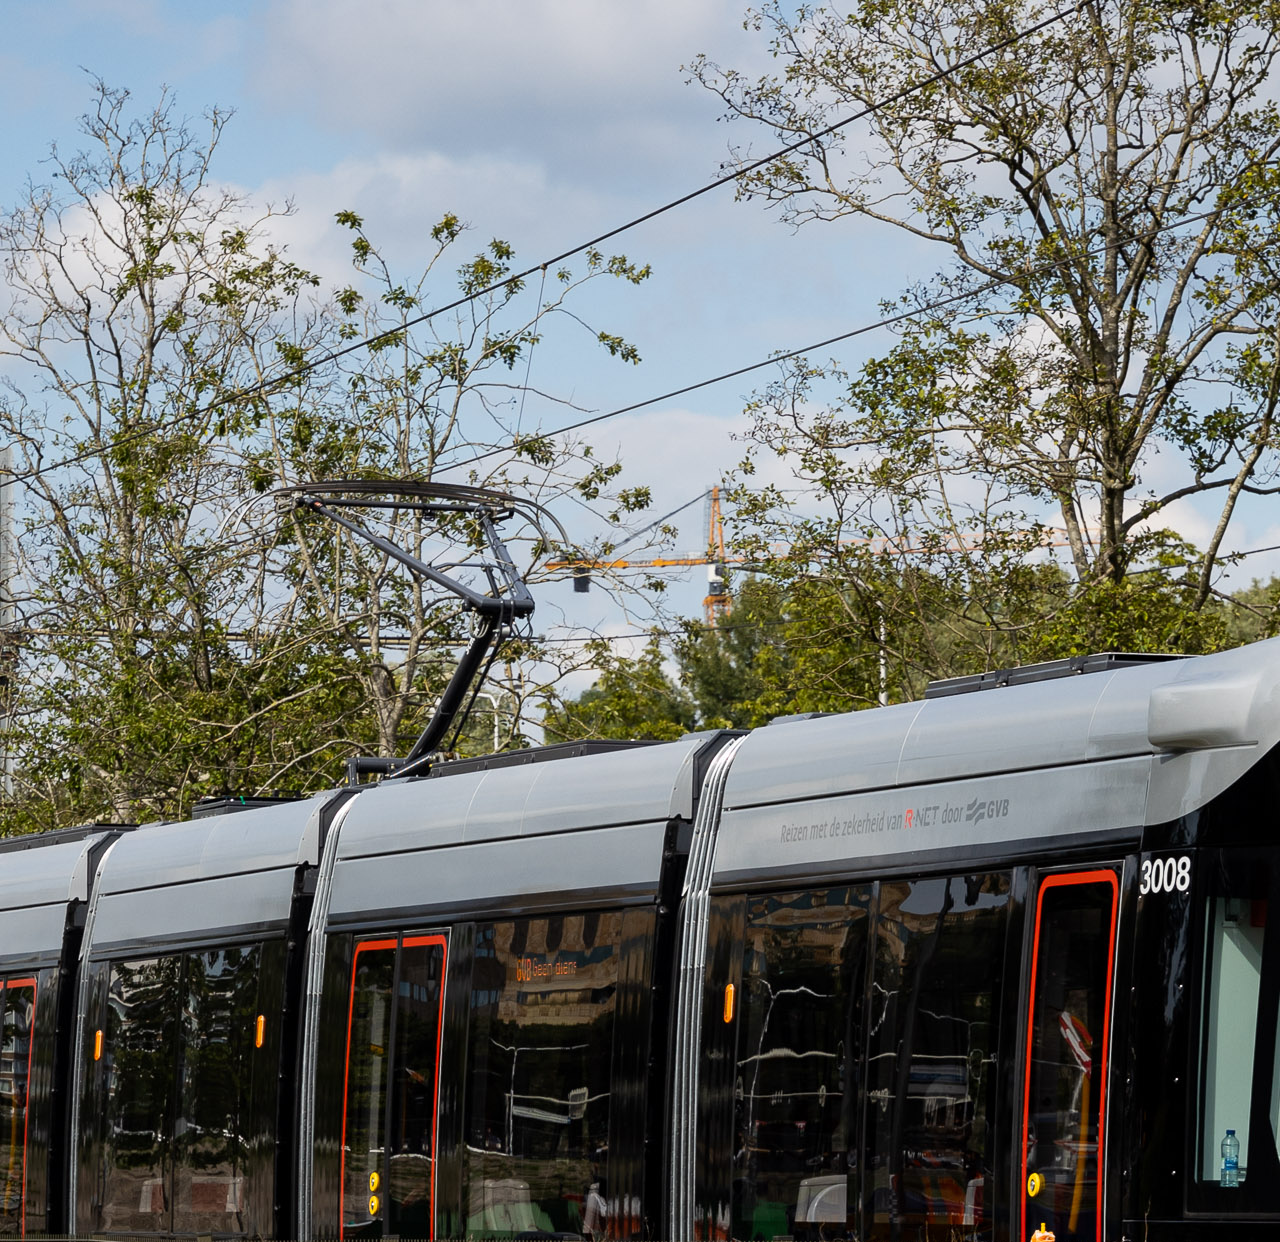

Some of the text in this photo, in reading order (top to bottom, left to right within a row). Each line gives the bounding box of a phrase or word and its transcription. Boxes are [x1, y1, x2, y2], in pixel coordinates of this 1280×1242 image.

[780, 824, 808, 843] Reizen
[809, 822, 829, 840] met
[829, 815, 841, 838] de
[841, 811, 884, 836] zekerheid
[886, 815, 903, 831] van
[942, 802, 963, 824] door
[987, 799, 1009, 819] GVB
[1140, 856, 1191, 894] 3008
